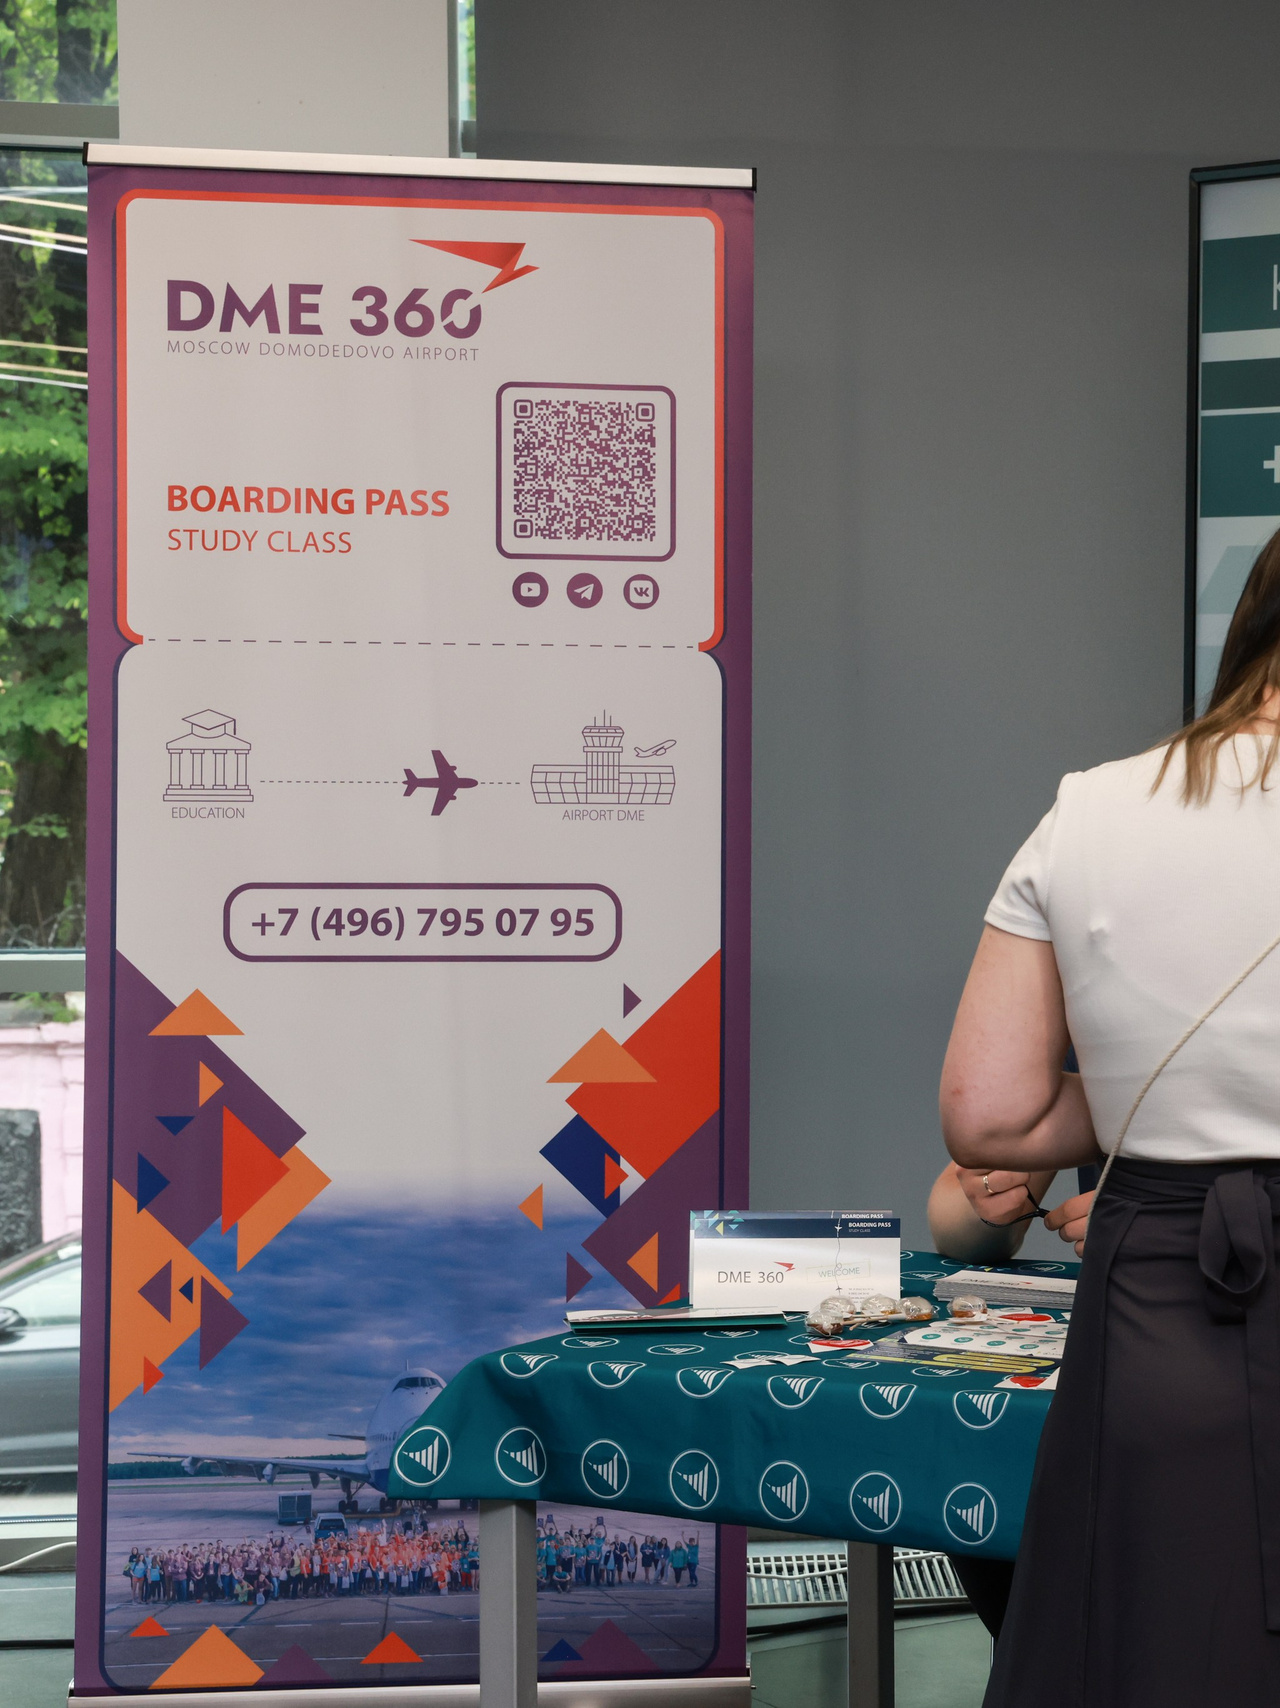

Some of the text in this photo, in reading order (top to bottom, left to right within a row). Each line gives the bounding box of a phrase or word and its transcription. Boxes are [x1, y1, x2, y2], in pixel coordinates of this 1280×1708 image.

[166, 279, 482, 339] DME 360
[167, 340, 480, 361] MOSCOW DOMODEDOVO AIRPORT
[167, 485, 450, 517] BOARDING PASS
[168, 528, 352, 553] STUDY CLASS
[171, 806, 245, 819] EDUCATION
[562, 809, 645, 821] AIRPORT DME
[251, 906, 595, 941] +7 (496) 795 07 95
[717, 1271, 784, 1284] DME 360
[818, 1267, 860, 1278] WELCOME
